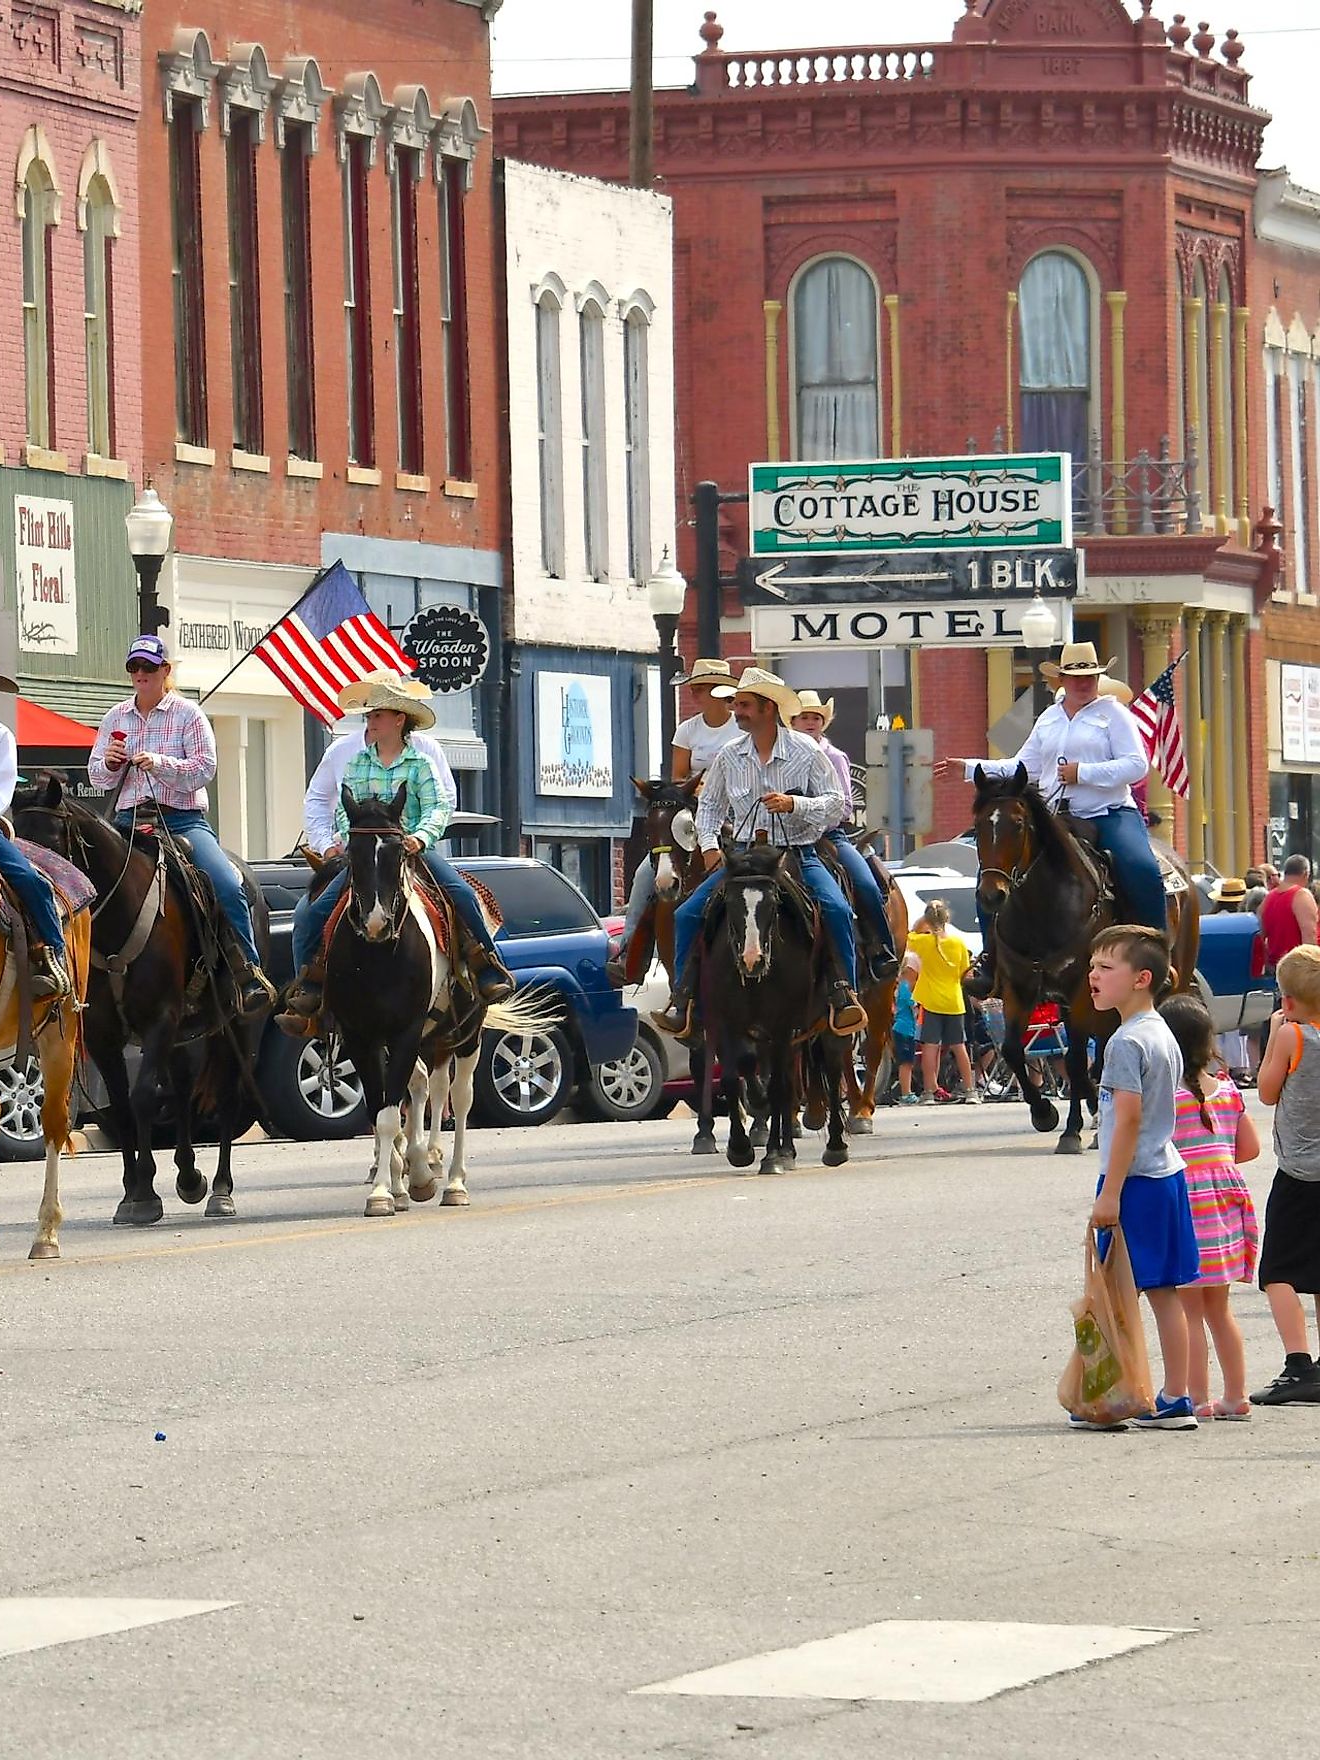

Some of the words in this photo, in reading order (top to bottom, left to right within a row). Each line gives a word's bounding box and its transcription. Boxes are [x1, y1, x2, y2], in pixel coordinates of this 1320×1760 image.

[894, 483, 922, 493] THE
[773, 493, 920, 527] COTTAGE
[931, 488, 1041, 522] HOUSE
[18, 507, 45, 548] Flint
[47, 511, 72, 550] Hills
[32, 563, 65, 604] Floral
[967, 561, 979, 589] 1
[179, 617, 231, 650] EATHERED
[790, 609, 1023, 642] MOTEL
[412, 639, 478, 655] Wooden
[419, 656, 472, 668] SPOON
